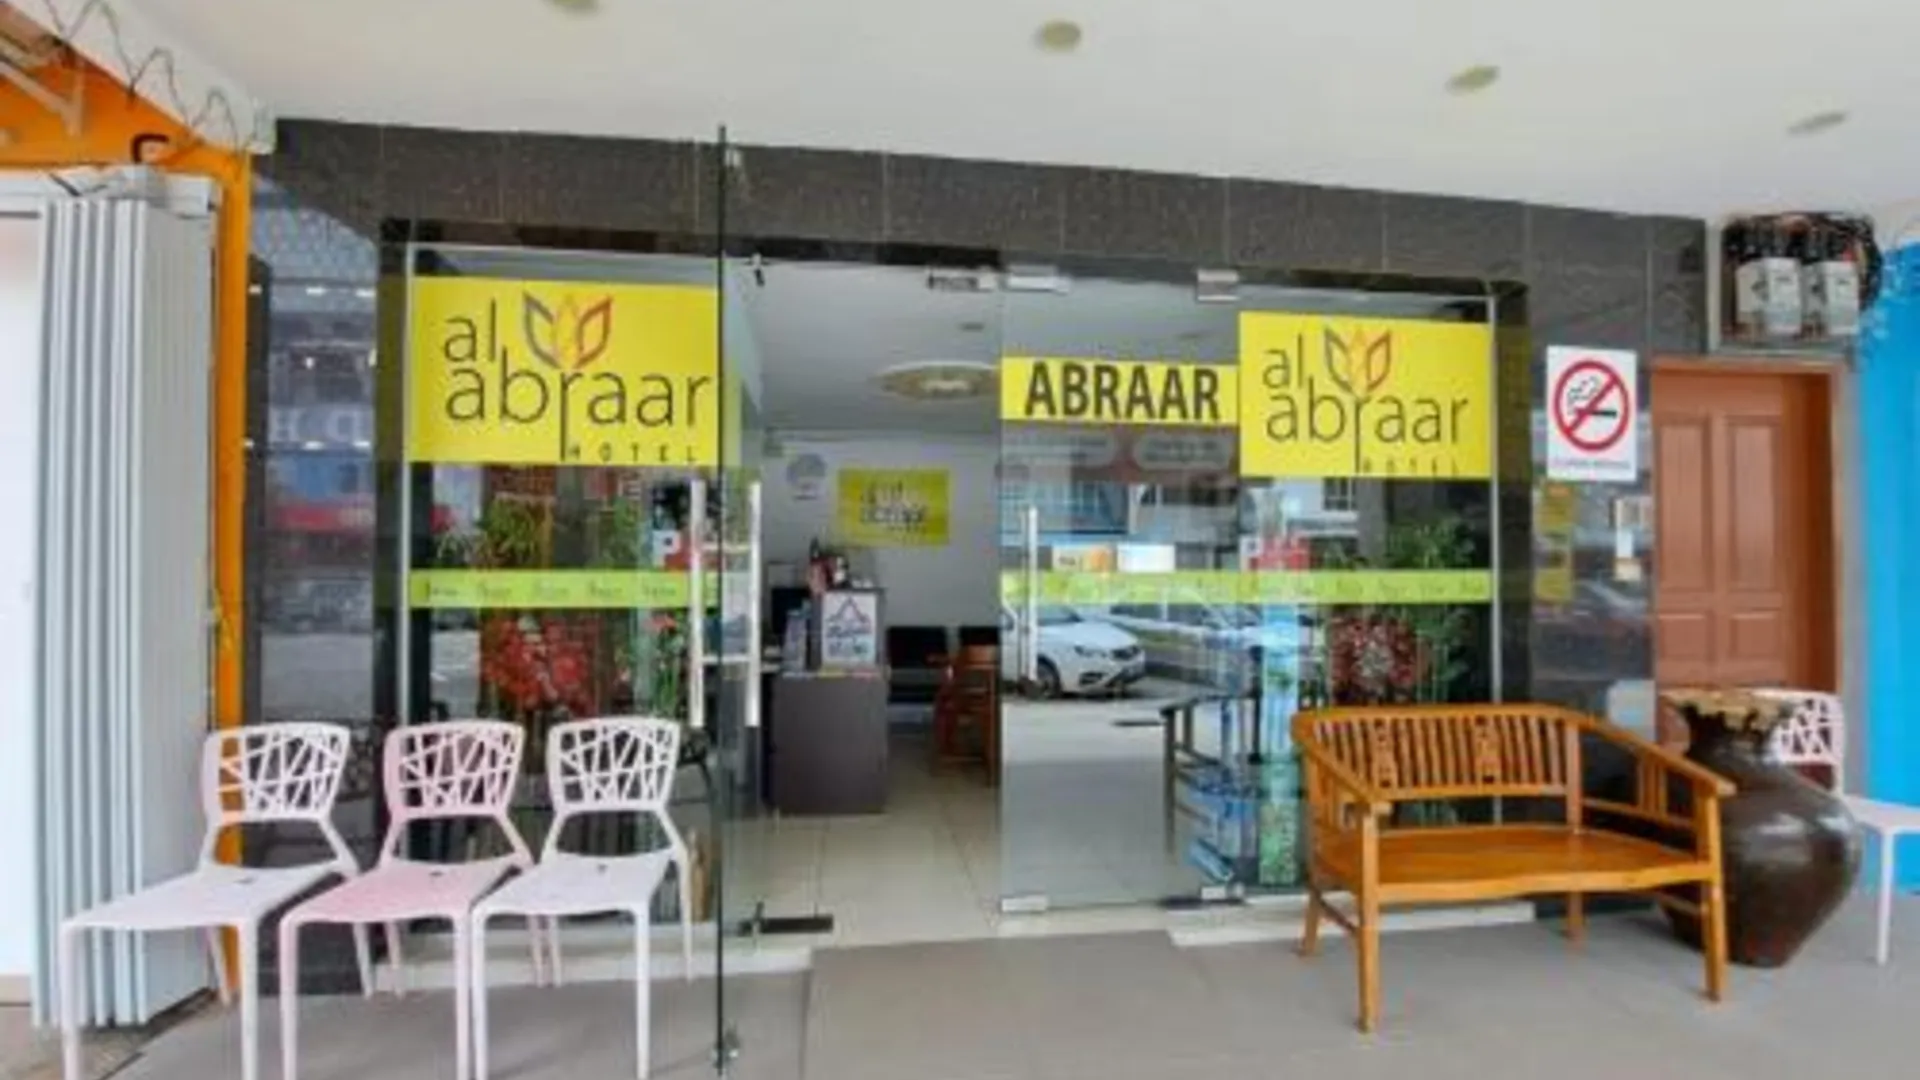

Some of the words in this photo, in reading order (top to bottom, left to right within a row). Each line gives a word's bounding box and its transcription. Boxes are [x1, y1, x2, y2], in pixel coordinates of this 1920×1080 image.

[443, 298, 496, 363] al
[1262, 333, 1304, 390] al
[445, 346, 711, 461] abraar
[1024, 361, 1221, 421] ABRAAR
[566, 441, 698, 462] HOTEL
[1266, 376, 1469, 473] abraar
